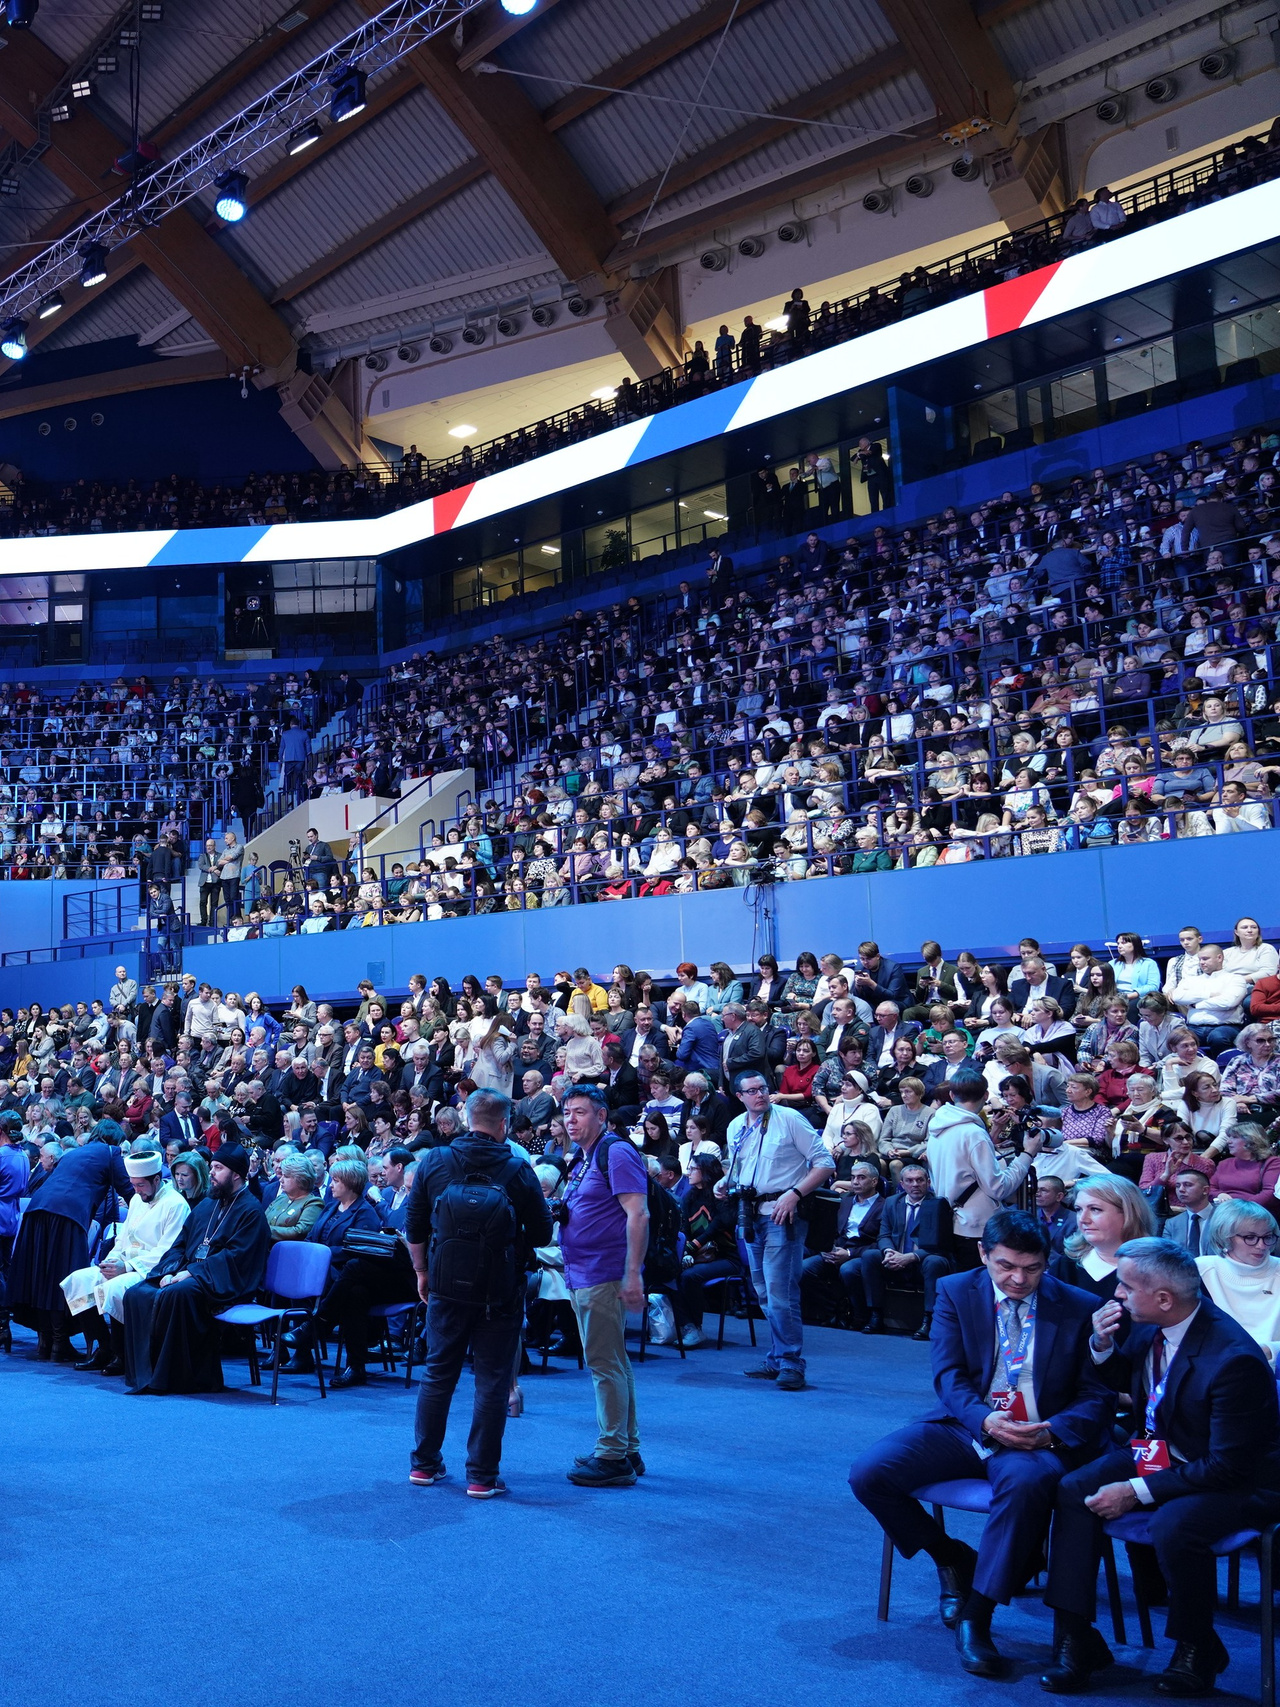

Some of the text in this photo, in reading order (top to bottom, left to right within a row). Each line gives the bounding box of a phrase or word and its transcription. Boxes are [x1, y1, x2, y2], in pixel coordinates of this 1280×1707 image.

[578, 1161, 589, 1178] SONY
[996, 1315, 1006, 1337] КУЗБАСС
[1018, 1331, 1029, 1353] КУЗБАСС
